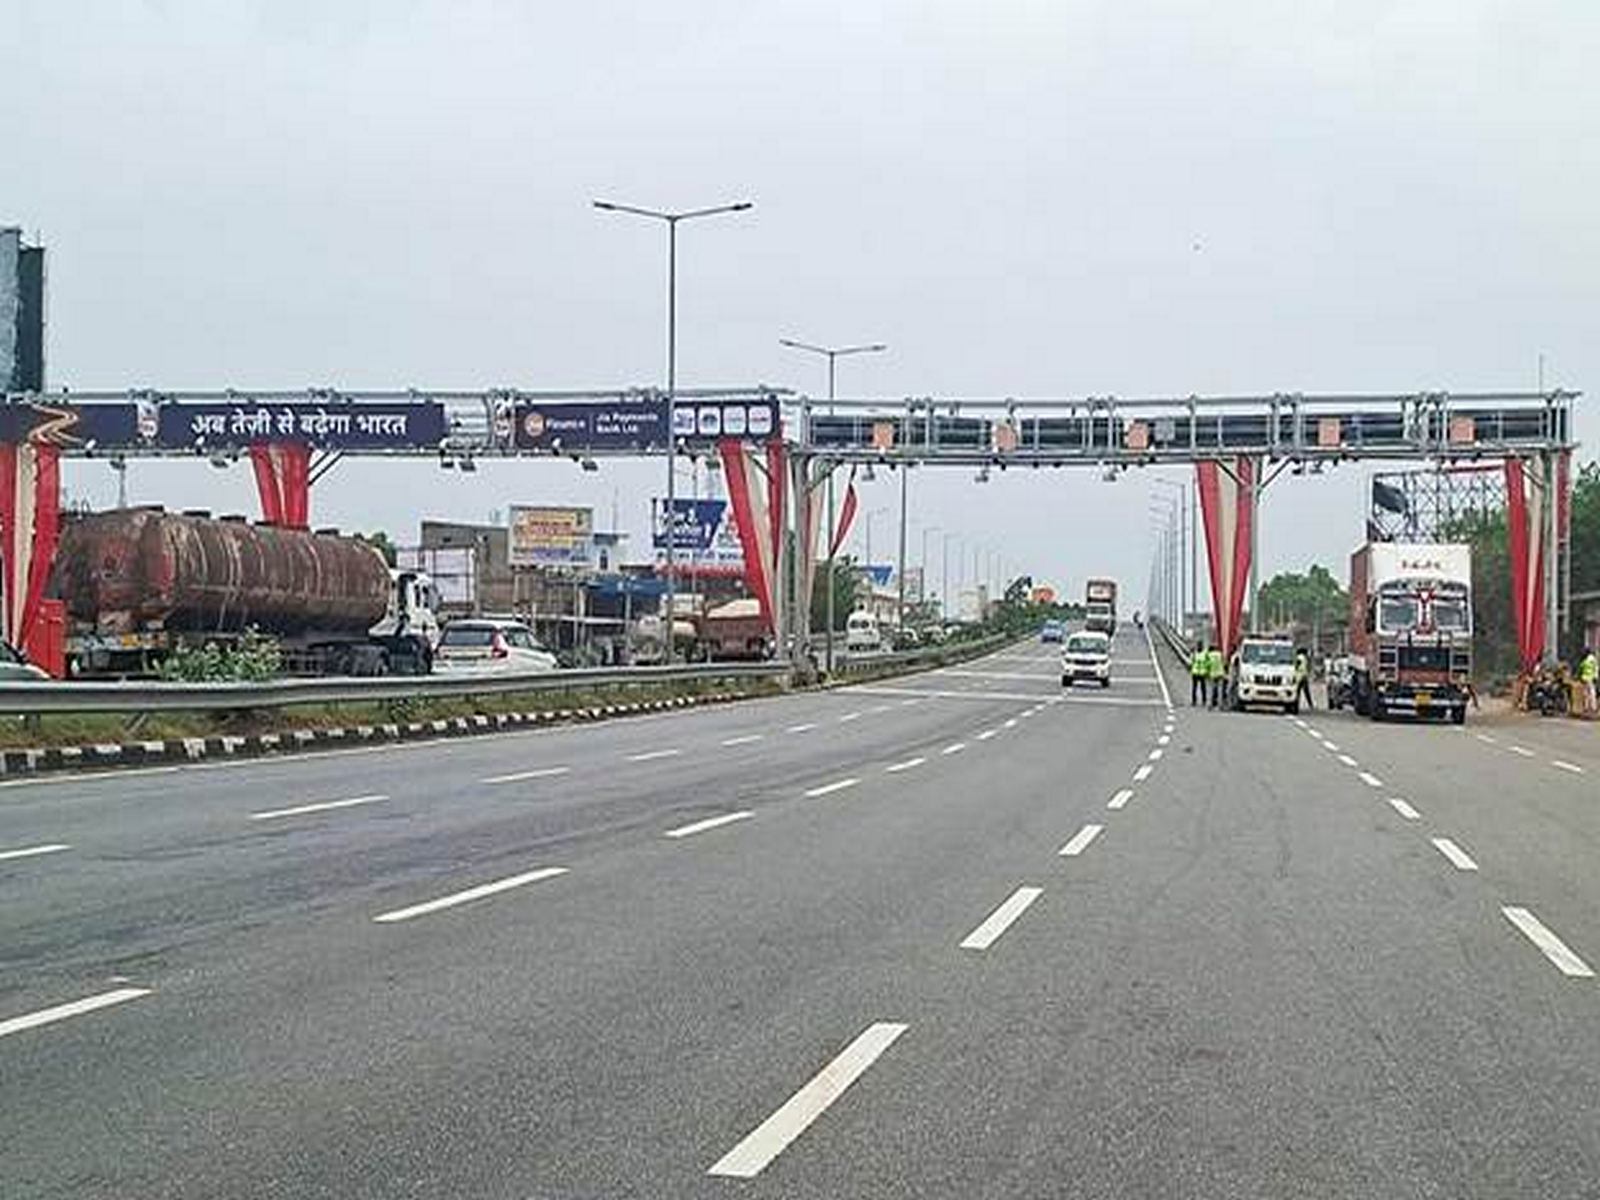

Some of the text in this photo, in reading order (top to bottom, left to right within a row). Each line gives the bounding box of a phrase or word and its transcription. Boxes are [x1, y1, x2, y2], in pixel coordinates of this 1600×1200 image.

[191, 414, 225, 434] अब
[277, 407, 294, 434] से
[356, 414, 407, 435] भारत
